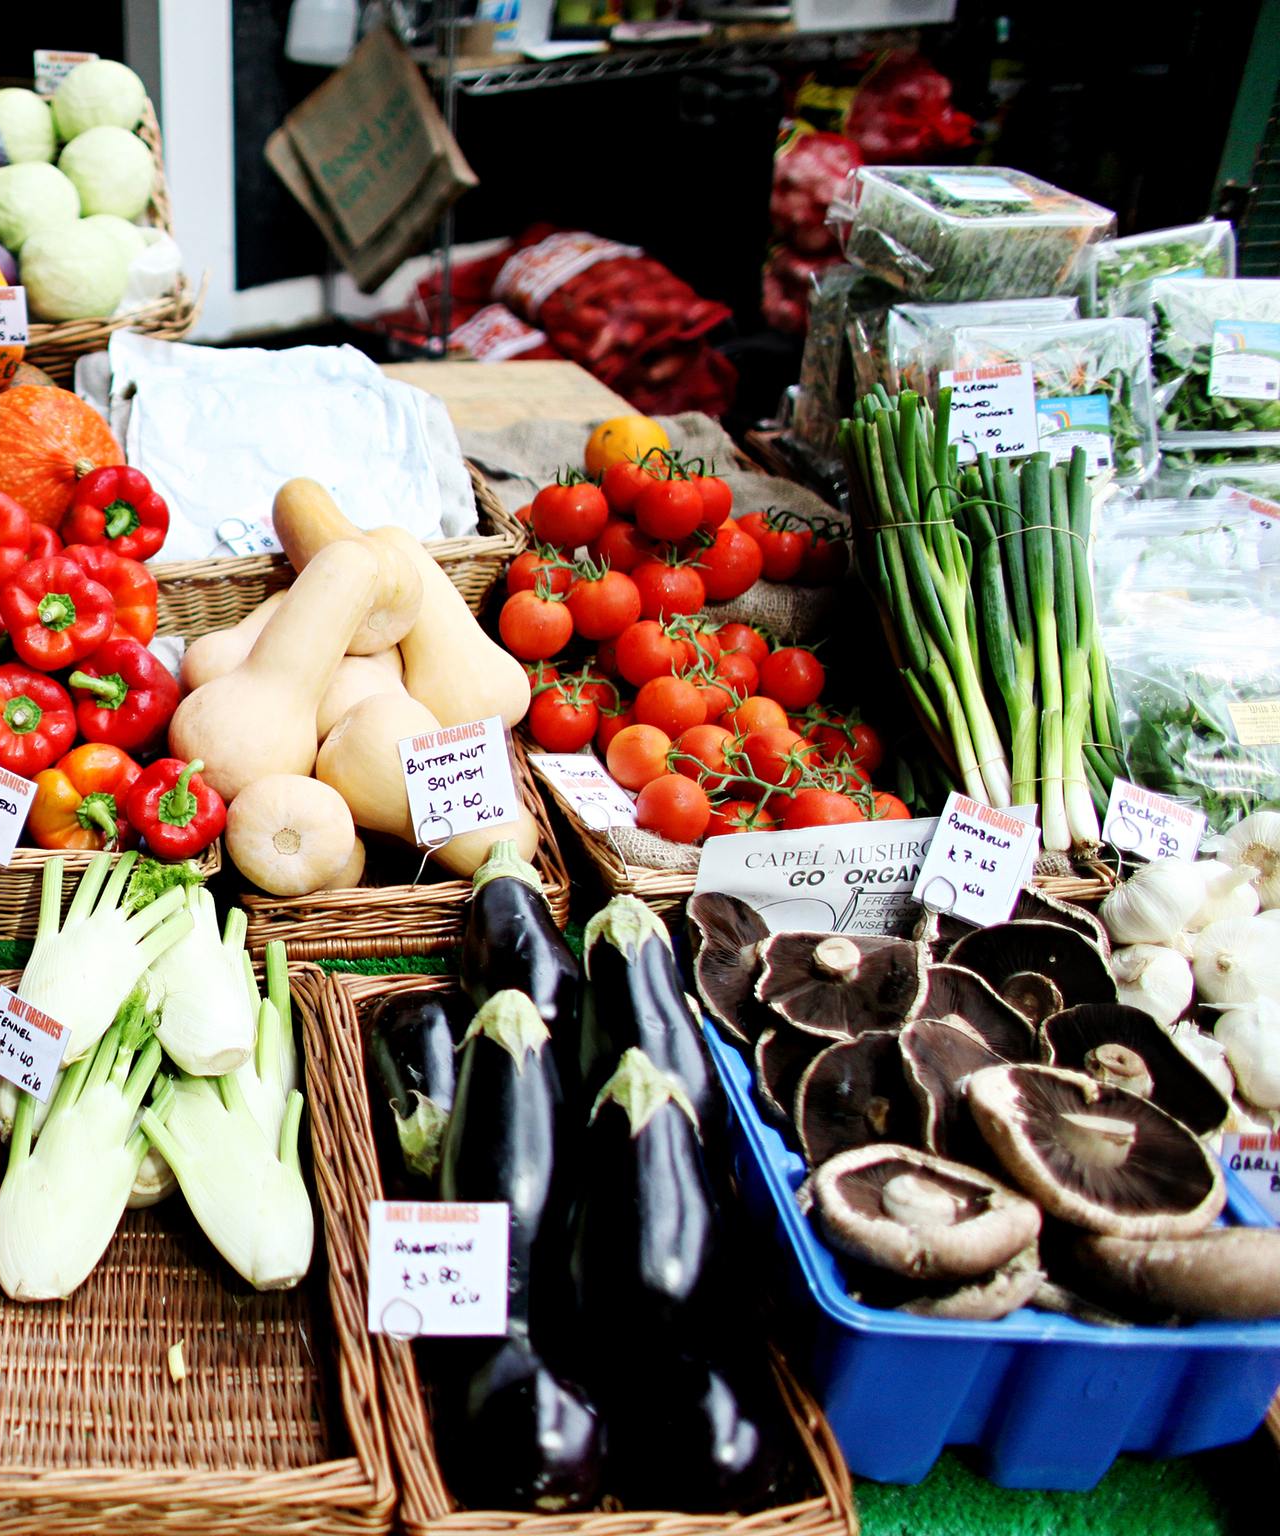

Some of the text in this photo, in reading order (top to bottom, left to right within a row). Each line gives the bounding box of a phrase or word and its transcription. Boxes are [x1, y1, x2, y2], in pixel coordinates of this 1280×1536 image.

[953, 363, 1023, 383] ONLY ORGANICS
[412, 721, 488, 753] ONLY ORGANICS
[427, 765, 486, 792] SQUASH
[954, 797, 1025, 838] ONLY ORGANICS
[1122, 784, 1195, 828] ONLY ORGANICS
[745, 838, 931, 869] CAPEL MUSHRO
[844, 863, 920, 885] ORGAN
[863, 895, 901, 906] FREE
[7, 995, 64, 1041] ONLY ORGANICS
[1239, 1133, 1267, 1152] ONLY
[1230, 1153, 1279, 1172] GARLI
[385, 1205, 480, 1223] ONLY ORGANICS
